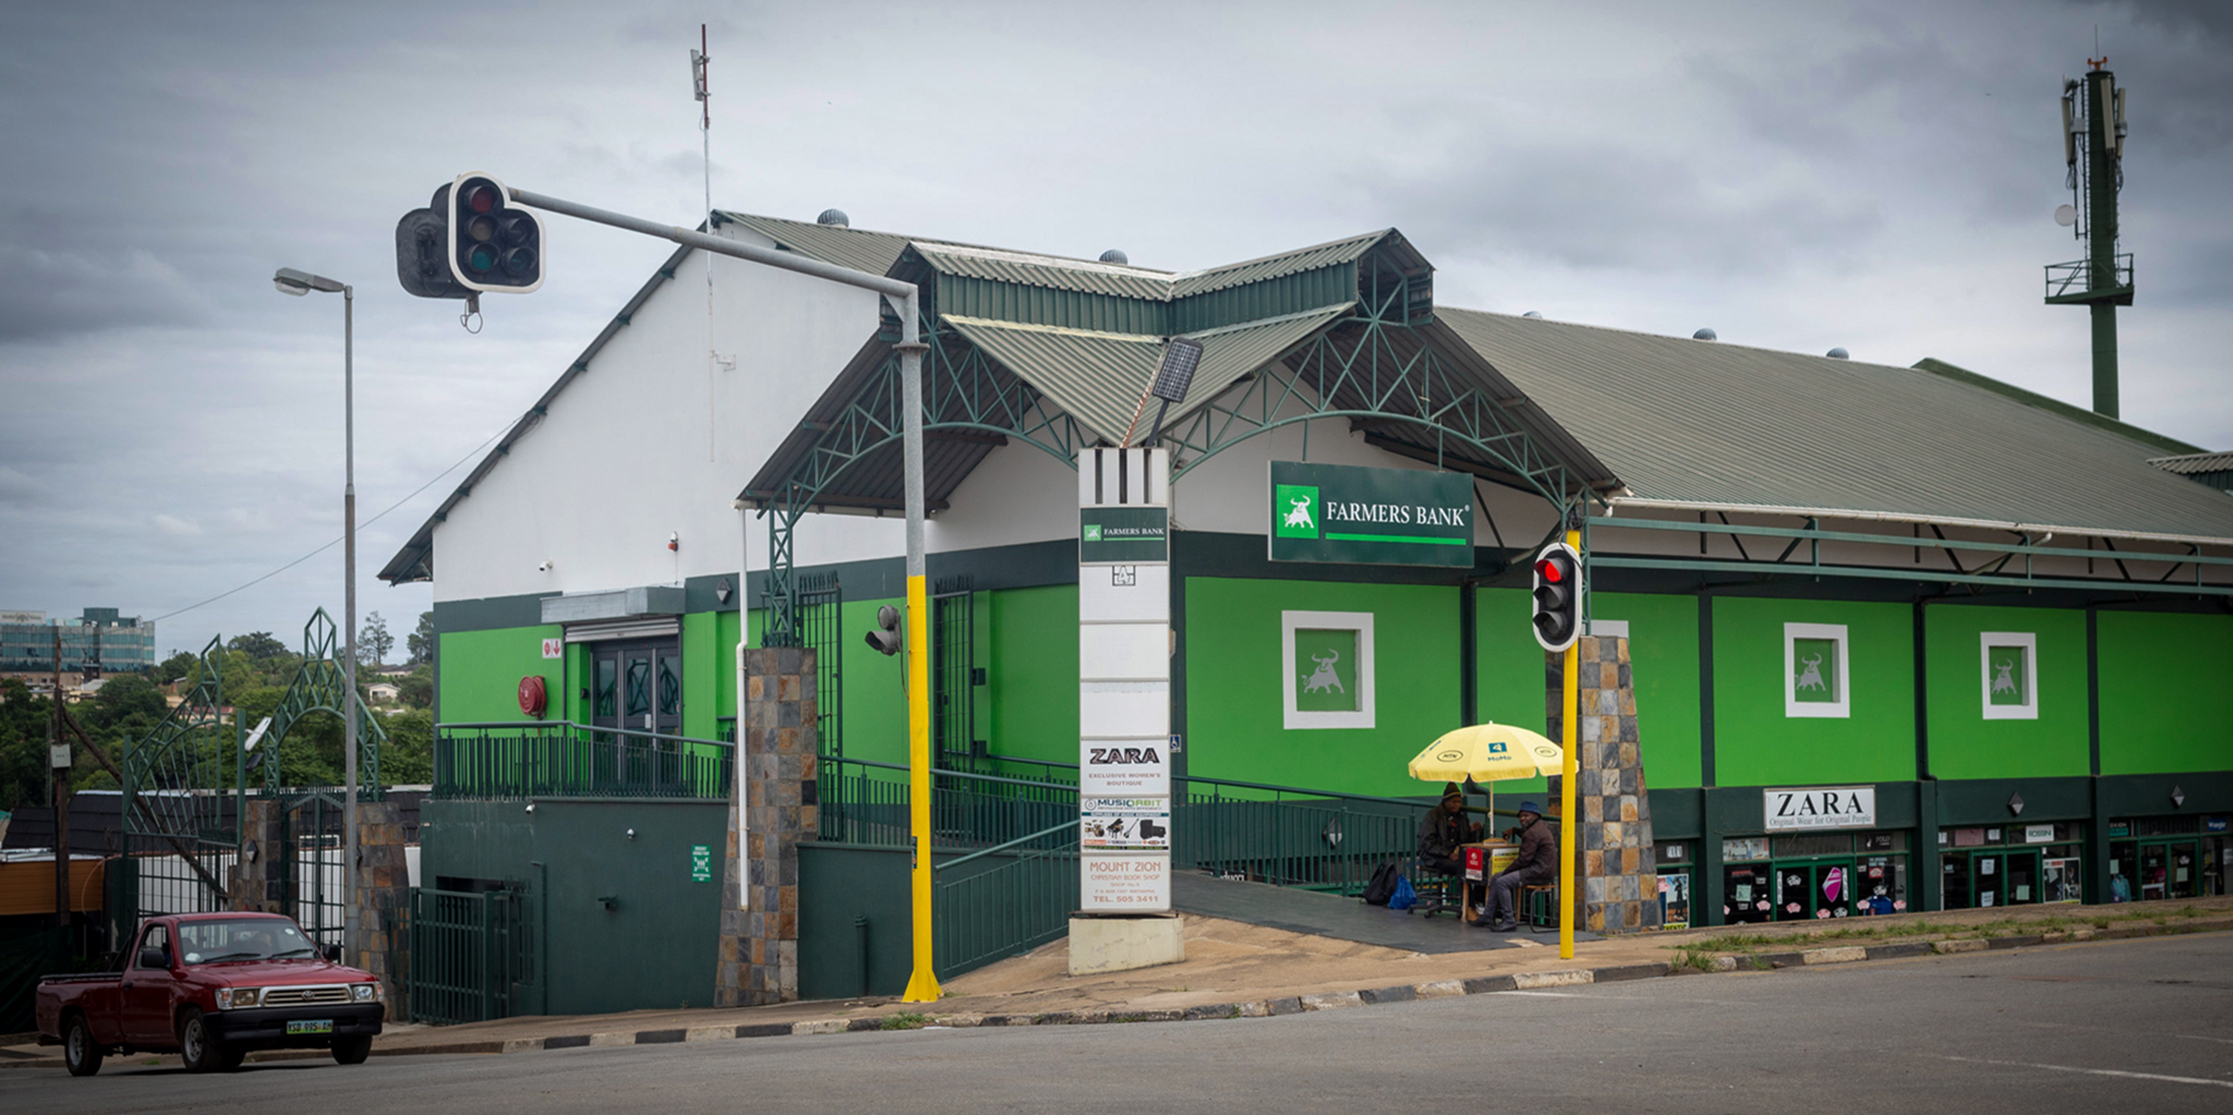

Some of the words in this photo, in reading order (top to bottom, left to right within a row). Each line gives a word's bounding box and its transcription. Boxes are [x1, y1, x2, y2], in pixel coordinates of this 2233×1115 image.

[1326, 501, 1410, 524] FARMERS
[1089, 748, 1160, 764] ZARA
[1777, 792, 1863, 816] ZARA
[1769, 818, 1794, 826] Original
[1797, 817, 1812, 825] Wear
[1815, 816, 1825, 824] for
[1826, 815, 1850, 825] Original
[1852, 814, 1871, 824] People
[1090, 862, 1130, 872] MOUNT
[1134, 862, 1161, 872] ZION
